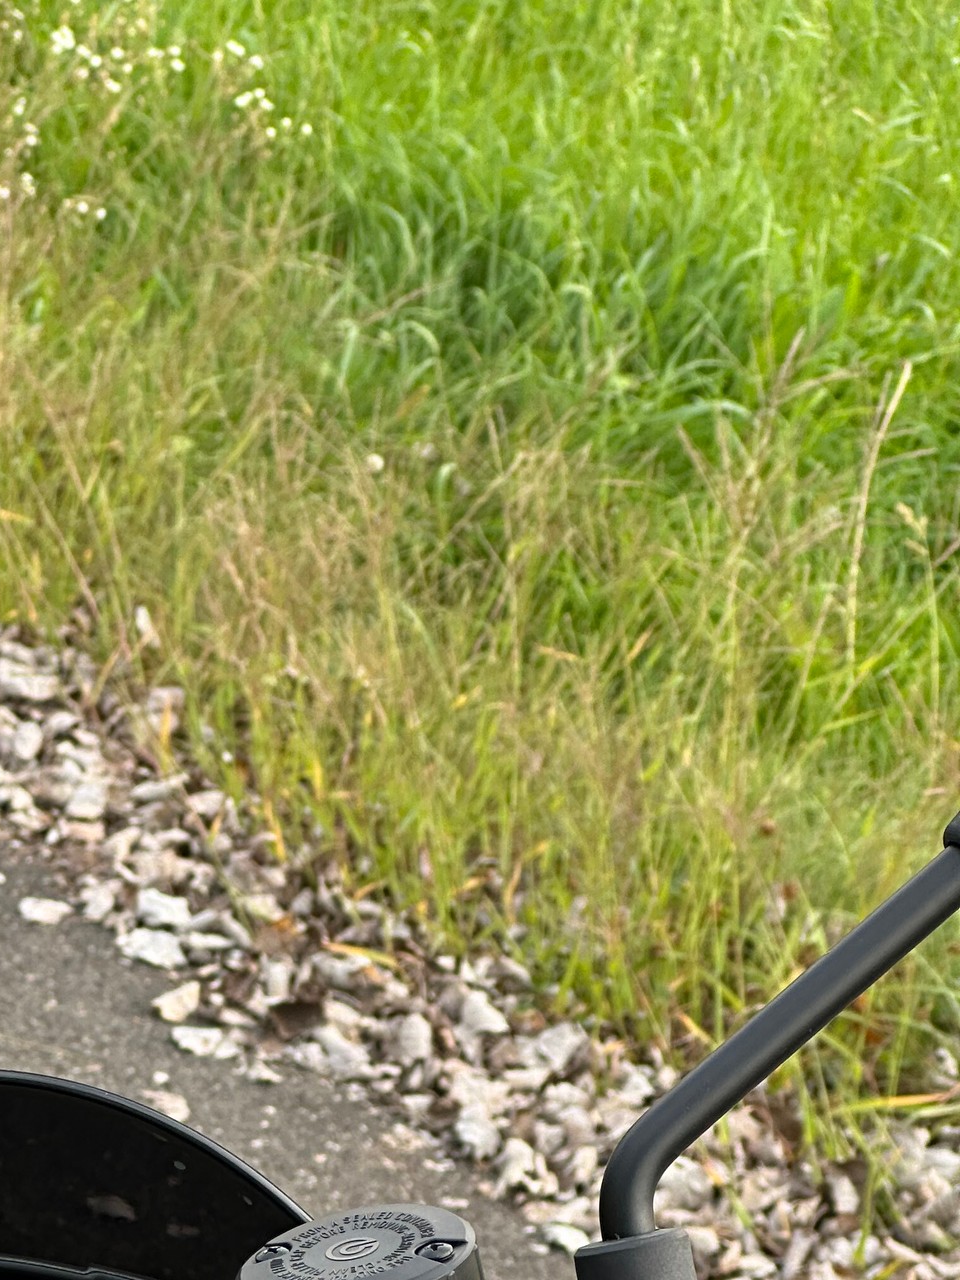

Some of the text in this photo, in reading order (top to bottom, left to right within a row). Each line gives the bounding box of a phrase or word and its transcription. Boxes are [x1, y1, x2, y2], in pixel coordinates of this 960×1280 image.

[292, 1225, 327, 1242] FROM
[343, 1211, 393, 1224] SEALED
[299, 1226, 346, 1249] BEFORE
